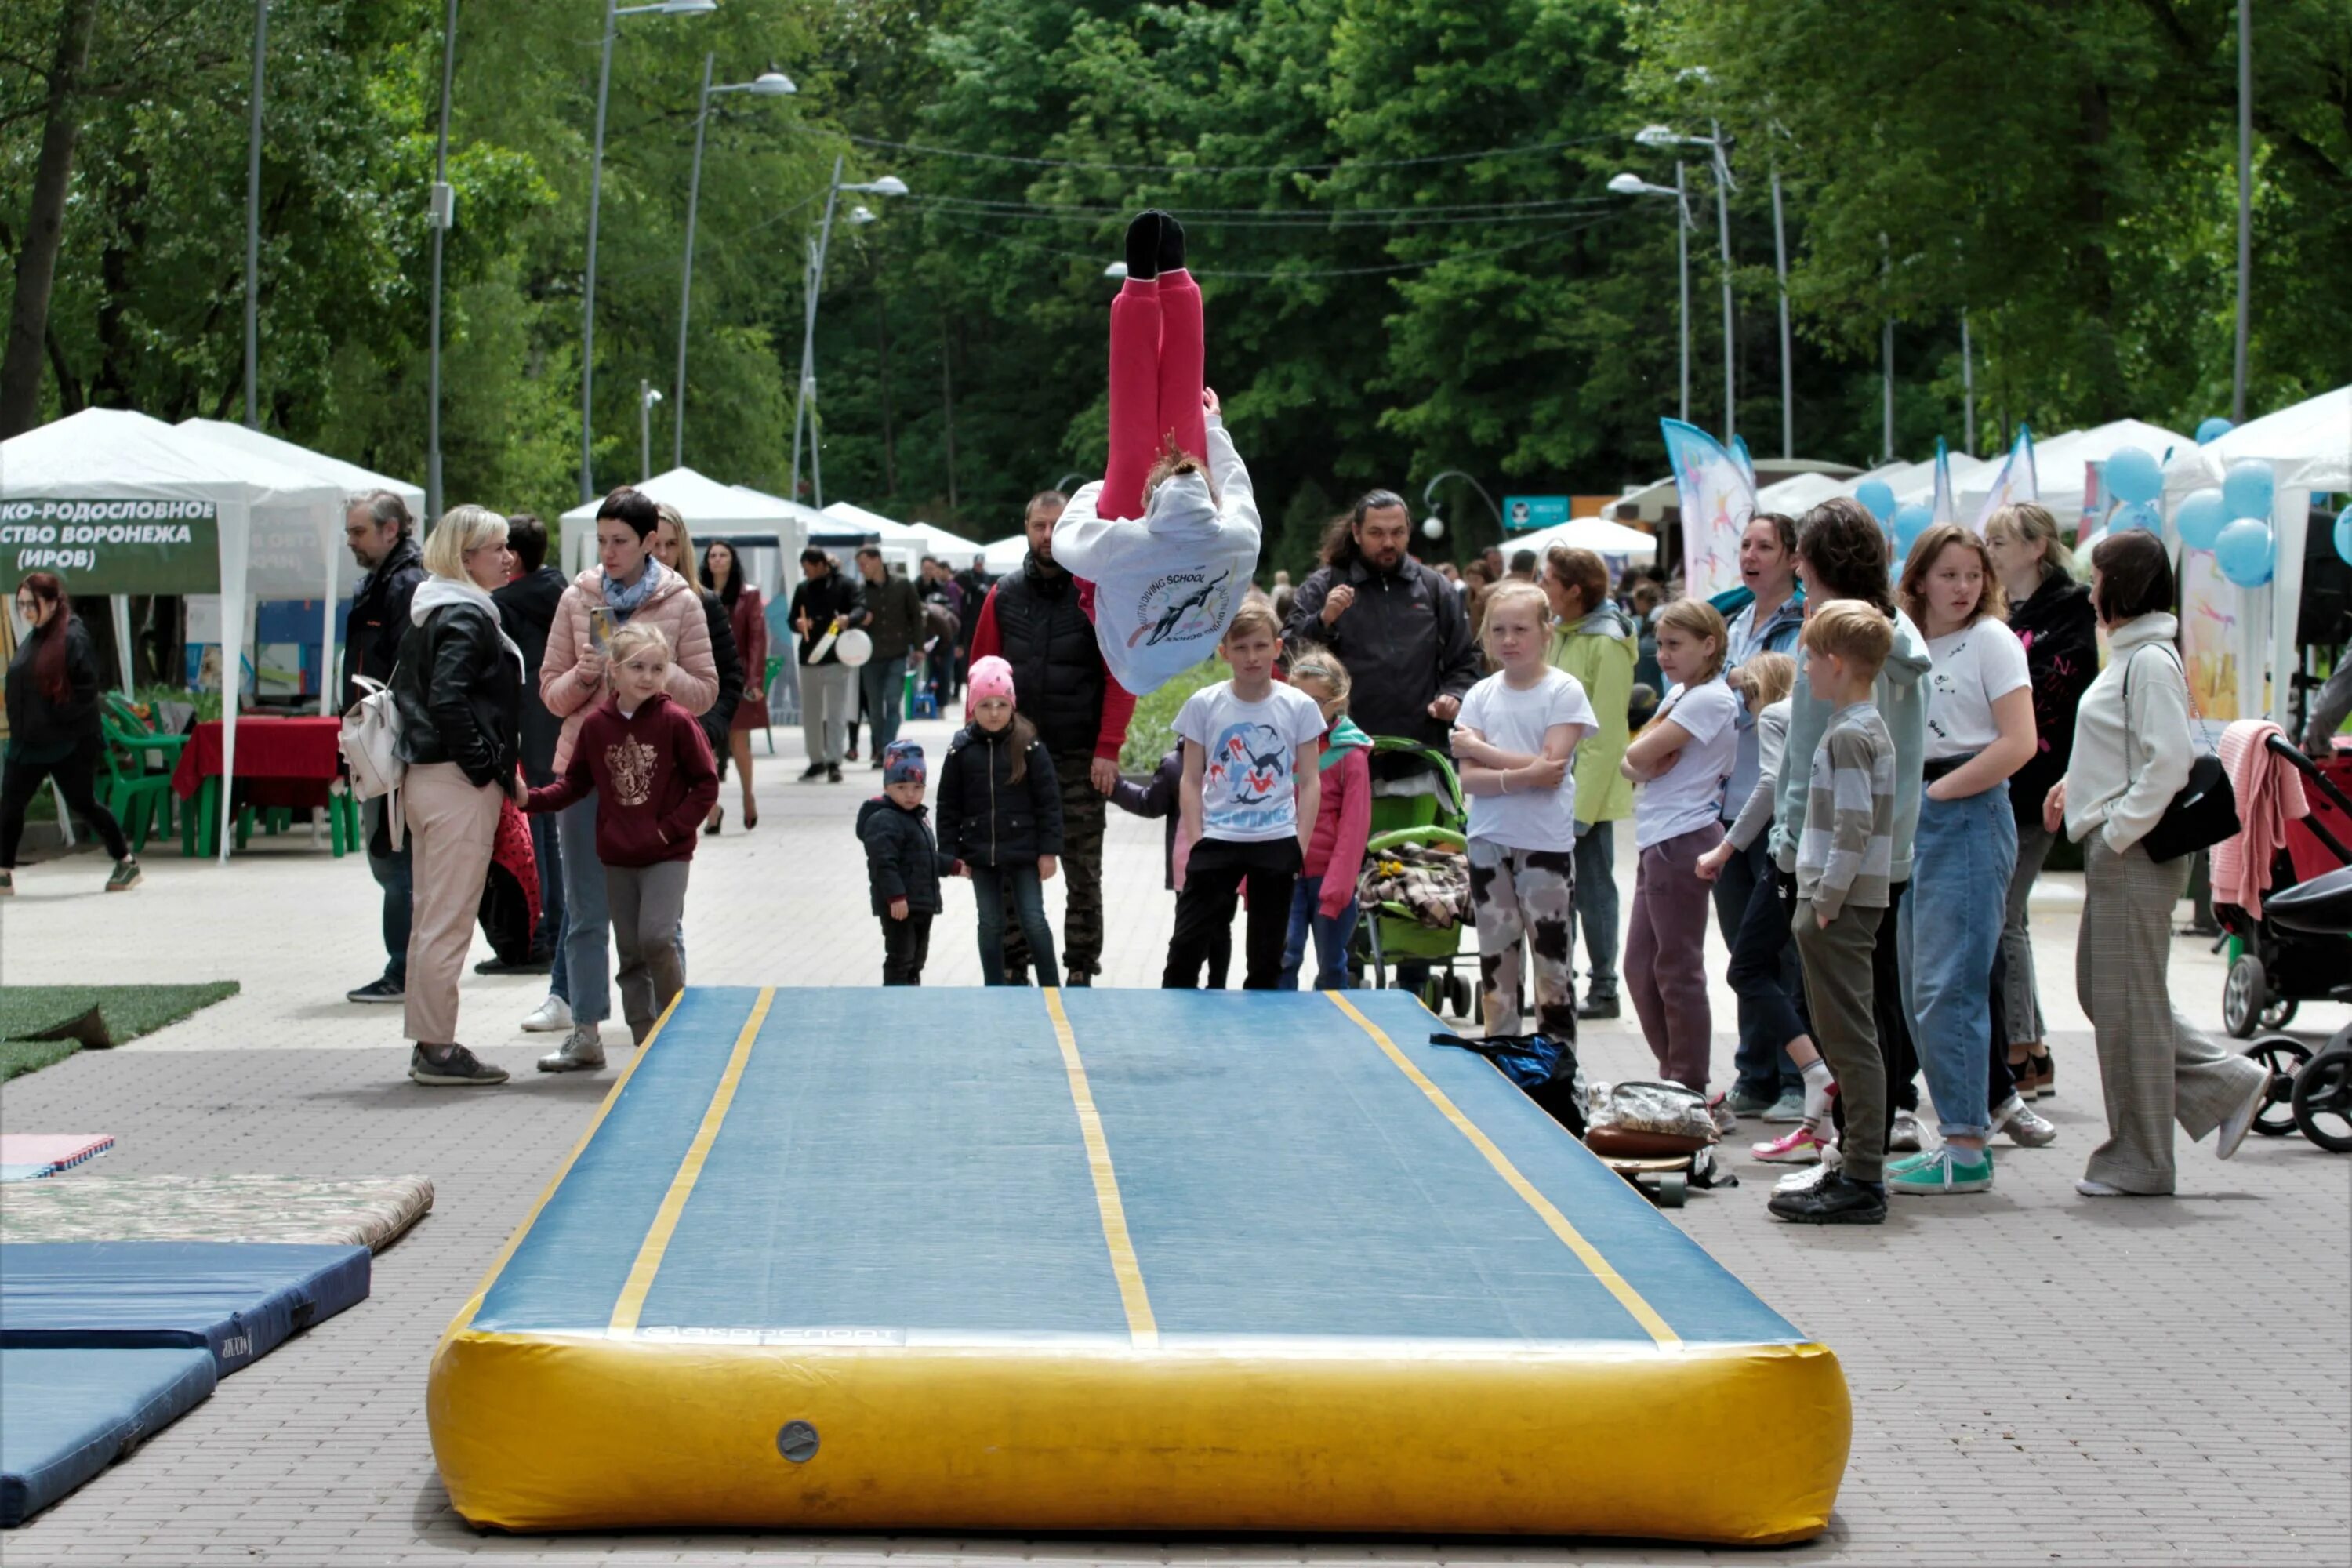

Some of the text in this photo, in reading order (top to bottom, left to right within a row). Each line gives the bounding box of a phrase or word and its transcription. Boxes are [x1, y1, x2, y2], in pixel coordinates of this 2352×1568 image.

[0, 502, 215, 523] КО-РОДОСЛОВНОЕ
[0, 524, 191, 543] СТВО ВОРОНЕЖА
[17, 548, 96, 572] (ИРОВ)
[1141, 579, 1166, 603] DIVING
[1167, 574, 1205, 585] SCHOOL
